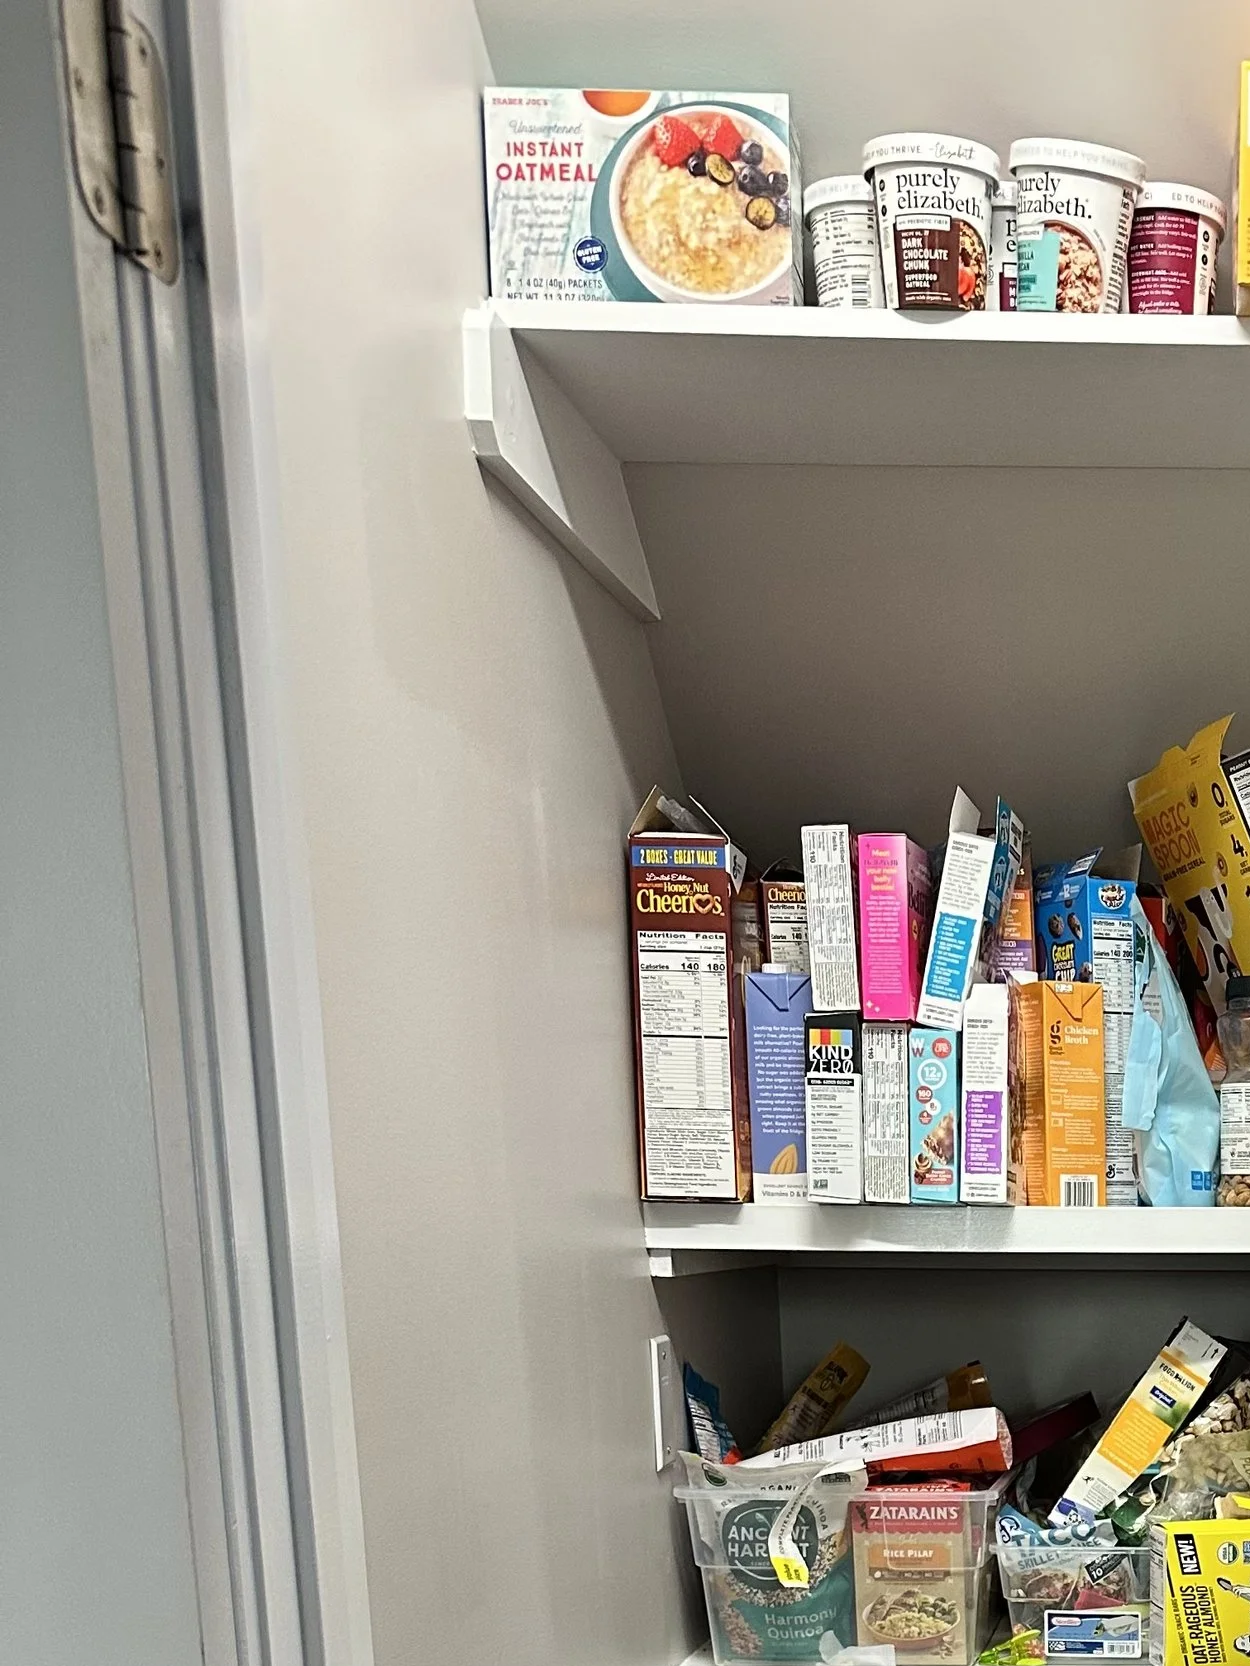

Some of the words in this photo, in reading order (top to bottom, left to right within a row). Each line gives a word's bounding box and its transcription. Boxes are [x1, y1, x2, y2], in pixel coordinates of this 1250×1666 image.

[506, 140, 584, 158] INSTANT
[495, 162, 599, 182] OATMEAL
[896, 168, 960, 194] purely
[901, 238, 923, 249] DARK
[903, 248, 949, 261] CHOCOLATE
[903, 260, 930, 271] CHUNK
[567, 278, 603, 289] PACKETS
[1142, 802, 1190, 843] MAGIC
[639, 850, 645, 863] 2
[646, 850, 668, 864] BOXES
[673, 850, 696, 865] GREAT
[696, 851, 718, 865] VALUE
[1153, 828, 1202, 872] SPOON
[663, 882, 691, 895] Honey
[691, 882, 709, 893] Nut
[767, 888, 807, 902] Cheerio
[1051, 943, 1075, 961] GREAT
[681, 962, 700, 970] 140
[706, 963, 726, 971] 180
[1064, 1025, 1099, 1036] Chicken
[1064, 1035, 1089, 1045] Broth
[809, 1045, 853, 1060] KIND
[762, 1190, 788, 1198] Vitamins
[869, 1505, 960, 1520] ZATARAIN'S
[727, 1524, 810, 1542] ANCNT
[727, 1541, 810, 1558] HART
[883, 1548, 905, 1558] RICE
[1177, 1539, 1199, 1574] NEW!
[1196, 1585, 1215, 1630] ALMOND
[764, 1606, 837, 1626] Harmony
[1180, 1584, 1209, 1665] OAT-RAGEOUS
[767, 1625, 825, 1640] Quinoa
[1205, 1632, 1222, 1664] HONEY
